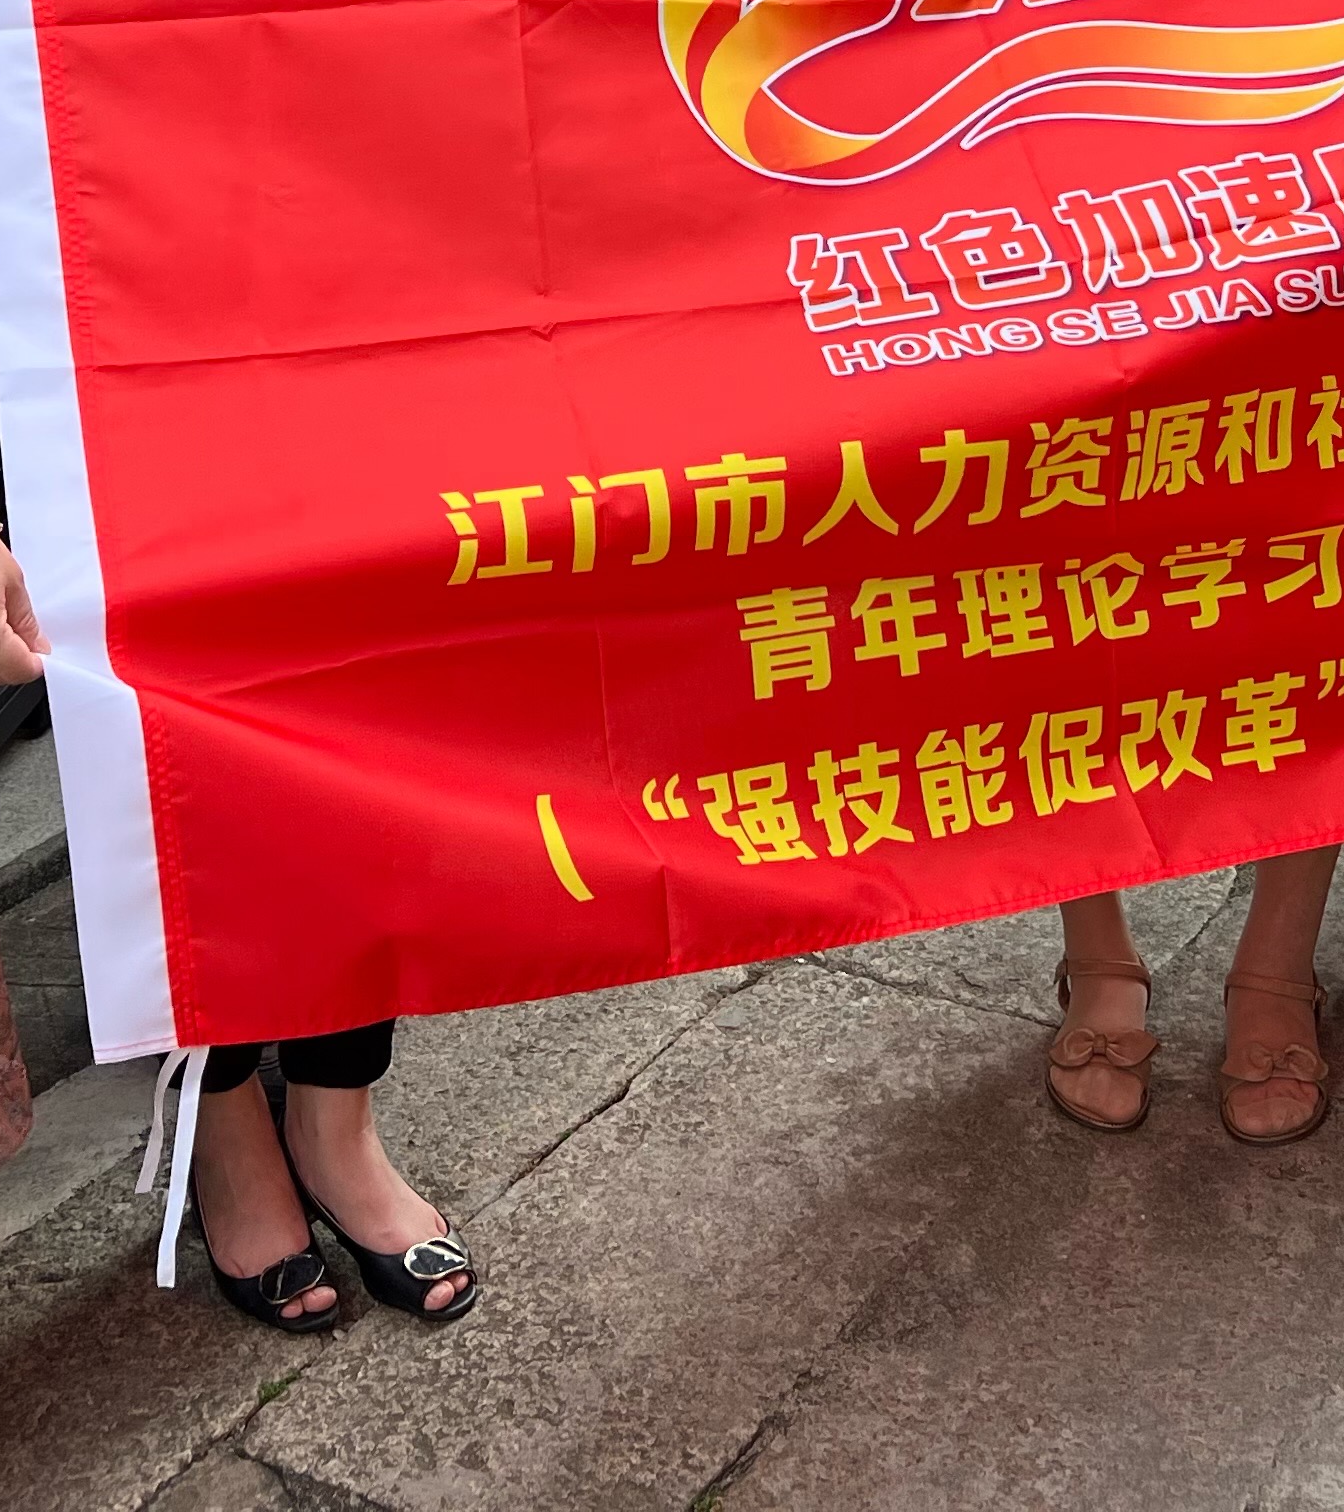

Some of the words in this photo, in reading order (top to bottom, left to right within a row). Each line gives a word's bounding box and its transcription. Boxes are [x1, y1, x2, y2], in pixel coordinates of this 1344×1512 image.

[821, 317, 1044, 376] HONG
[1047, 300, 1149, 346] SE
[1153, 278, 1273, 330] JIA
